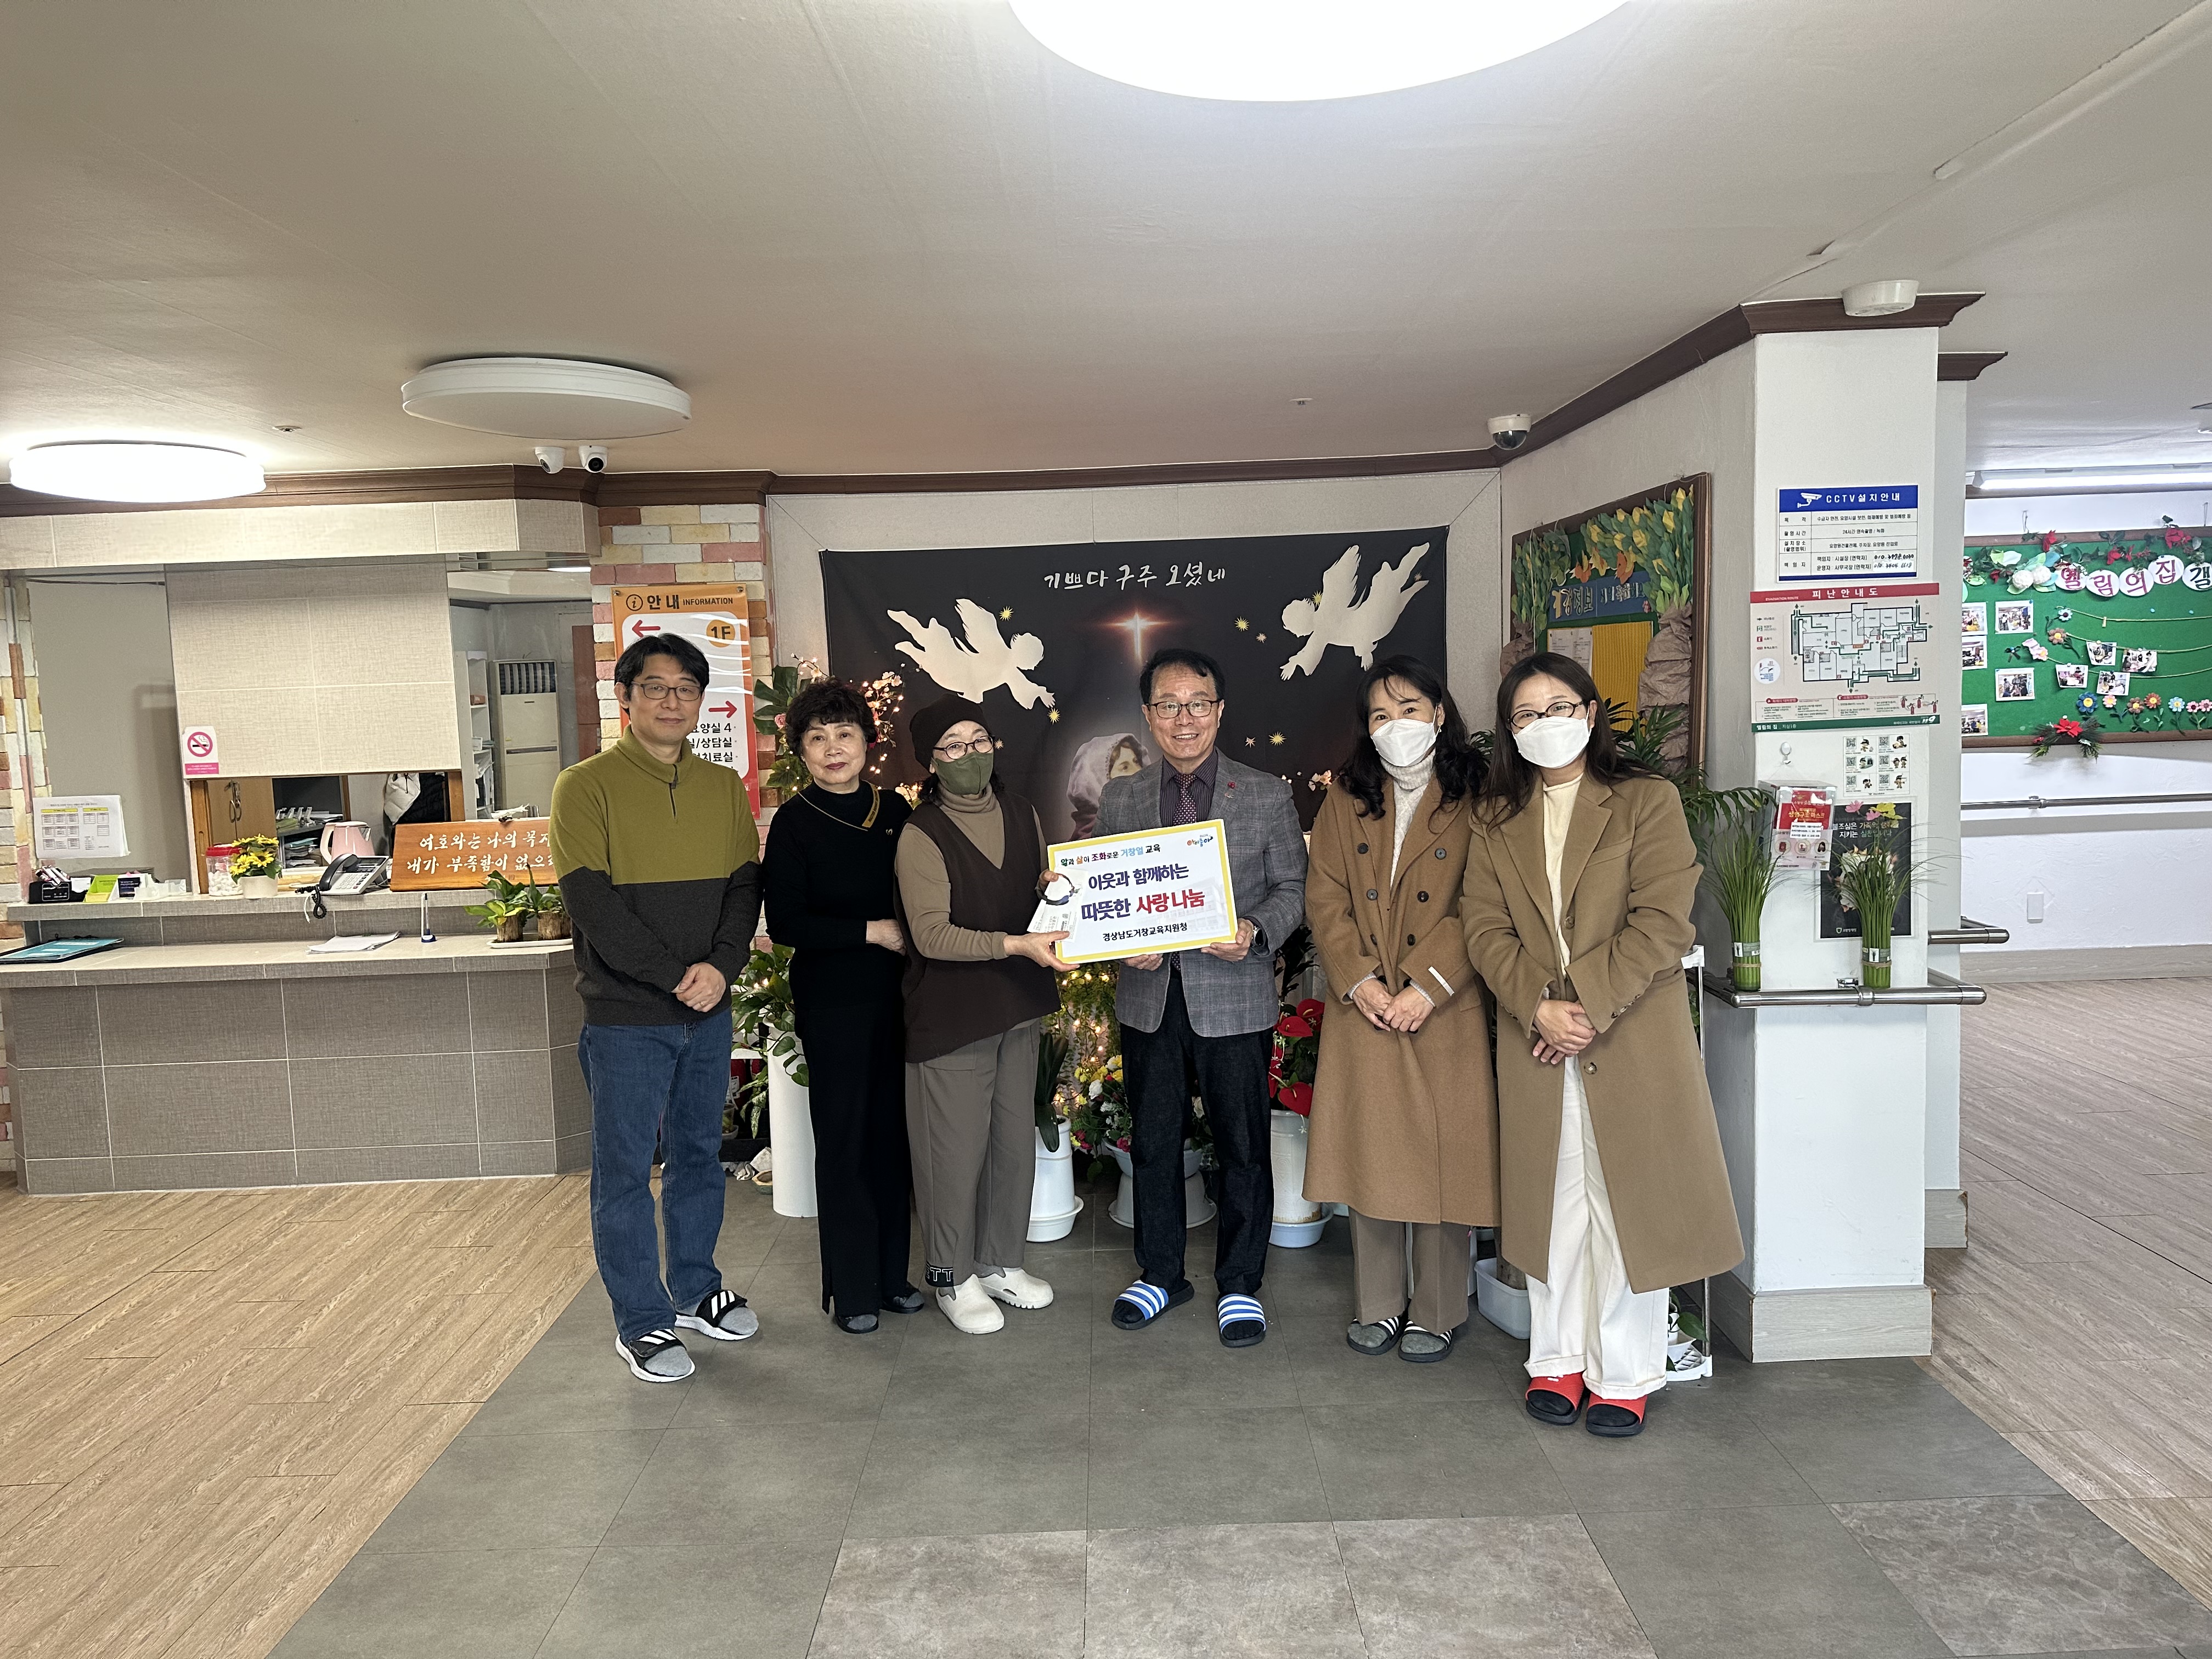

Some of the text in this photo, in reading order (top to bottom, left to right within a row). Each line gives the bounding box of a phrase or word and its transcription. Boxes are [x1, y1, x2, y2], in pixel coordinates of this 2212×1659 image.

[1043, 561, 1226, 590] 기쁘다 구주 오셨네
[646, 594, 733, 610] 안내 INFORMATION
[710, 625, 731, 640] 1F
[724, 723, 732, 732] 4
[419, 832, 481, 851] 여호와는
[487, 830, 517, 849] 나의
[1839, 830, 1859, 838] 지키는
[1091, 851, 1119, 862] 조화로운
[1145, 844, 1161, 854] 교육
[407, 855, 439, 874] 내가
[446, 853, 508, 872] 부족함이
[1088, 863, 1189, 891] 이웃과 함께하는
[1081, 888, 1205, 922] 따뜻한 사랑 나눔
[1102, 922, 1188, 942] 경상남도거창교육지원청
